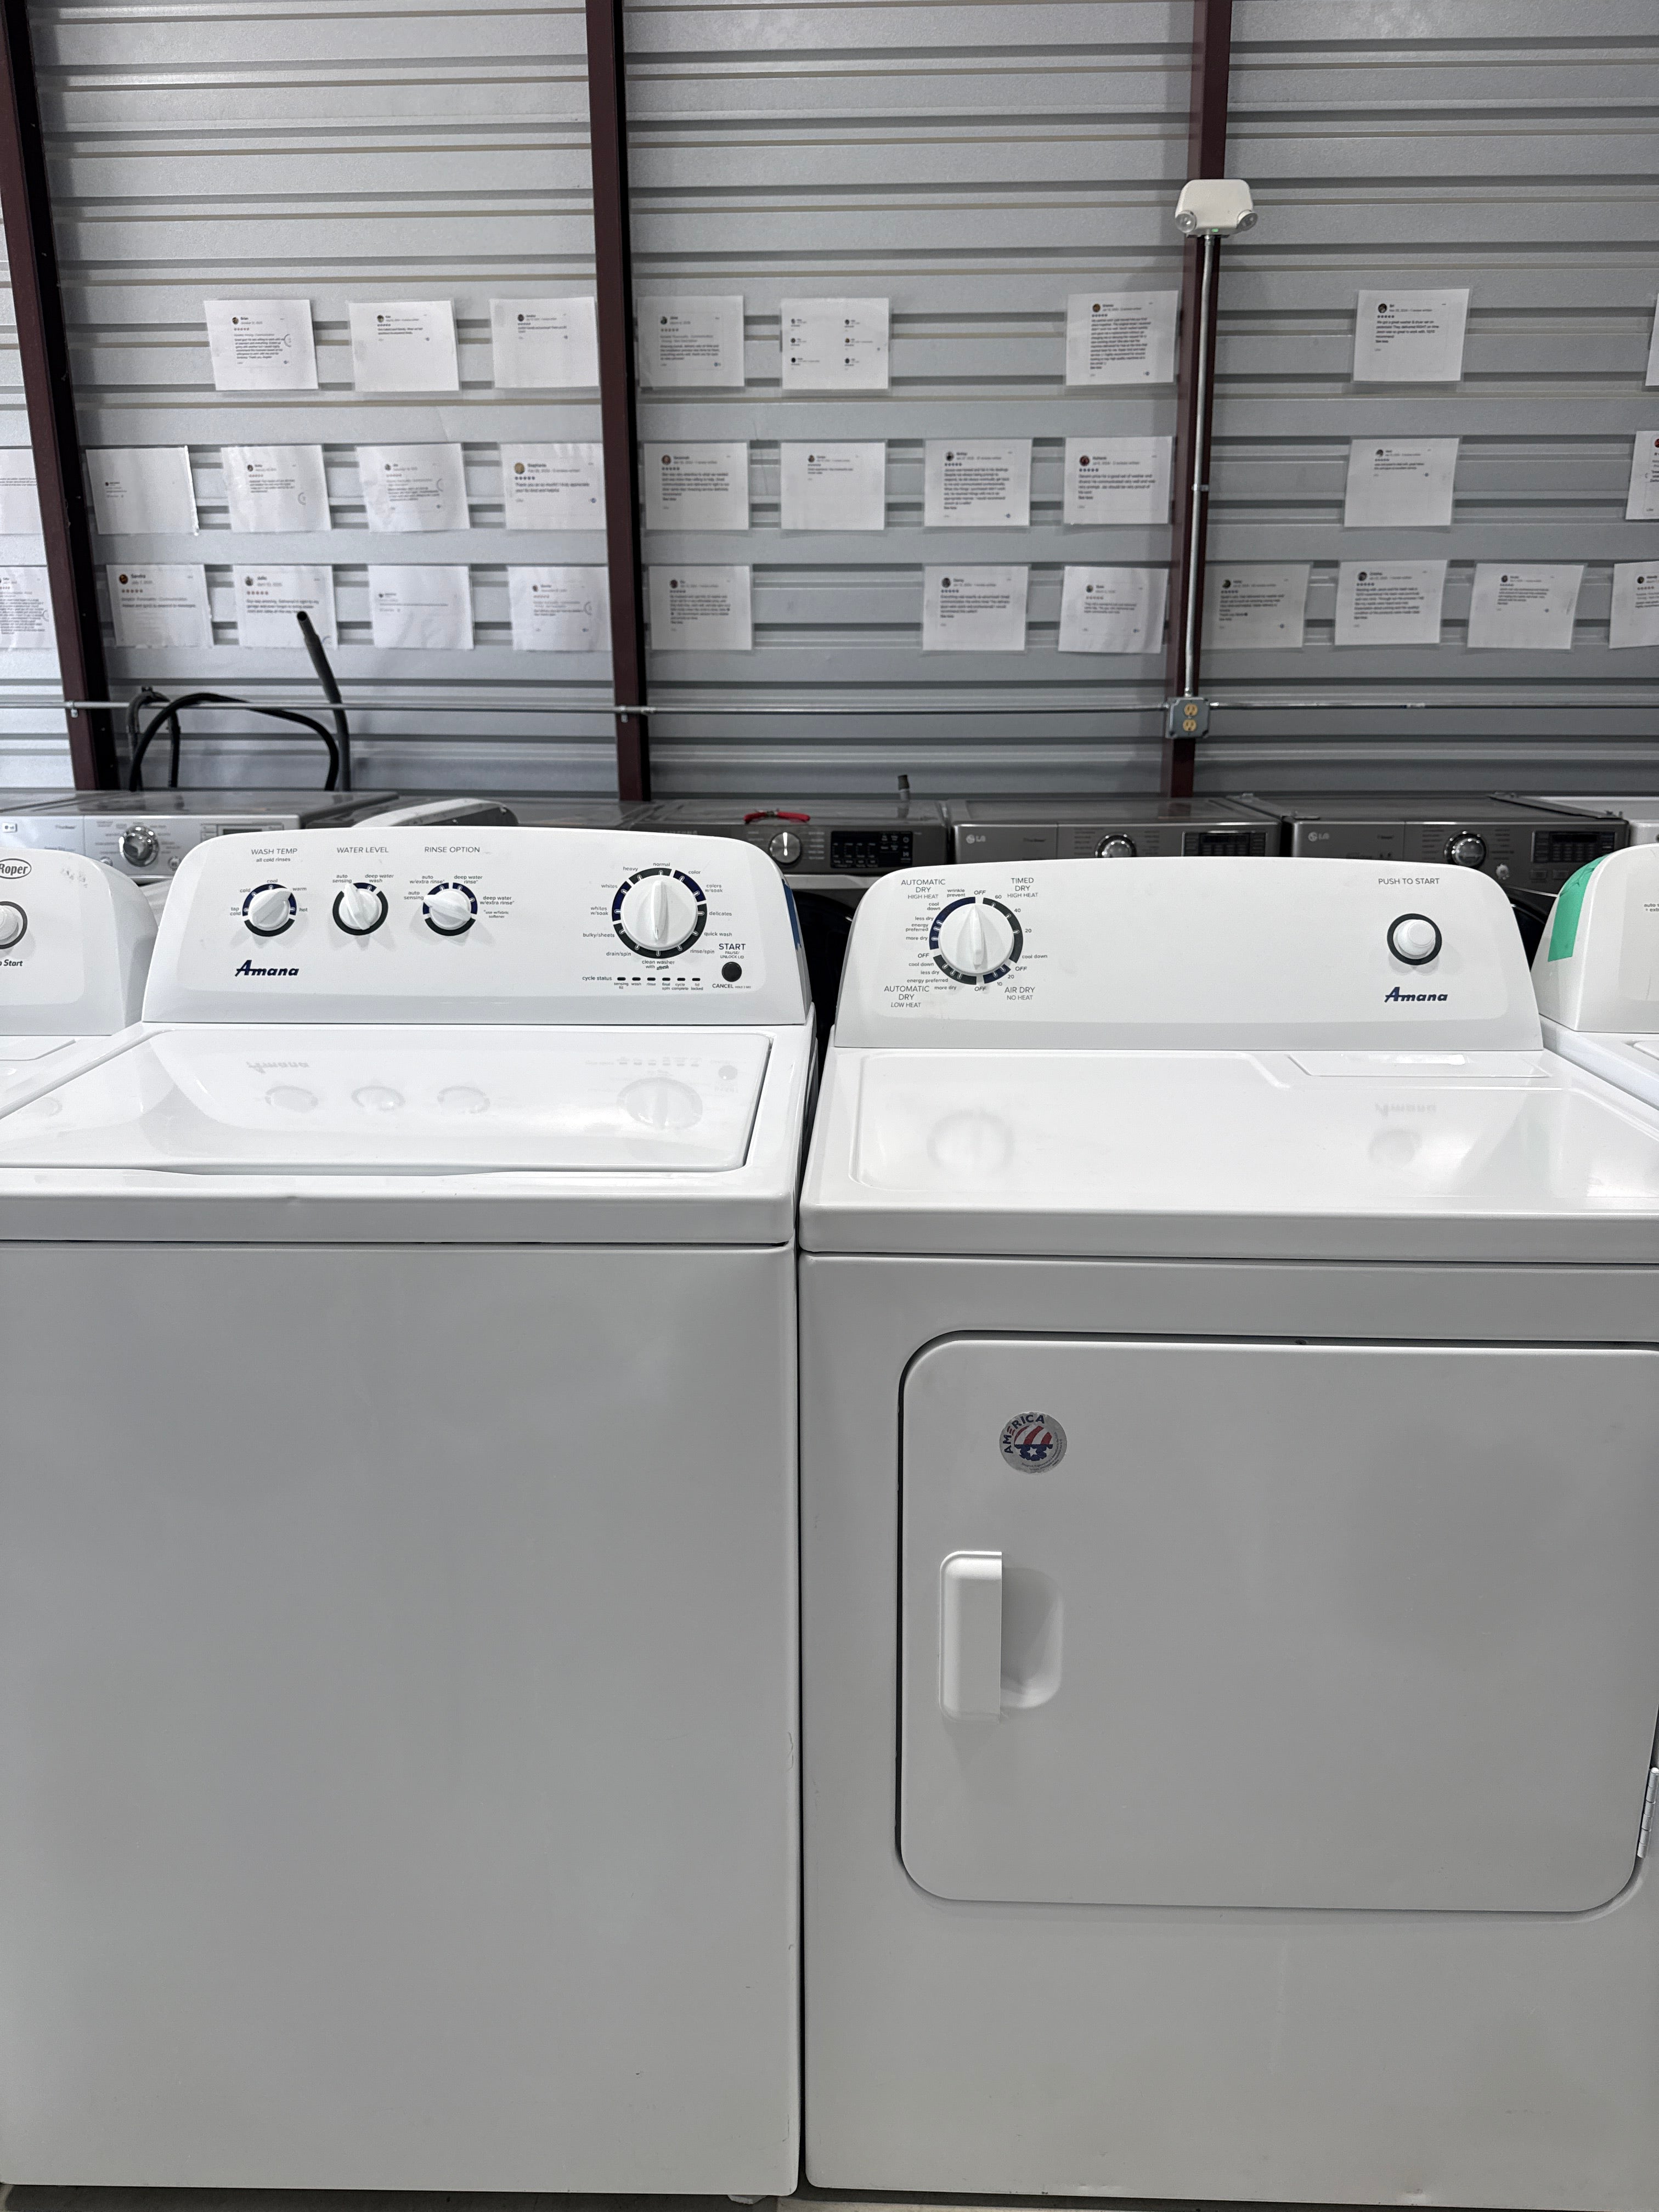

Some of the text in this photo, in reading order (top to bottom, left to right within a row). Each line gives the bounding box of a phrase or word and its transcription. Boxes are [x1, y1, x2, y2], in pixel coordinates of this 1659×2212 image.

[0, 864, 28, 876] Roper
[234, 960, 300, 977] Amana
[1384, 986, 1448, 1003] Amana
[1003, 1414, 1045, 1454] AMERICA
